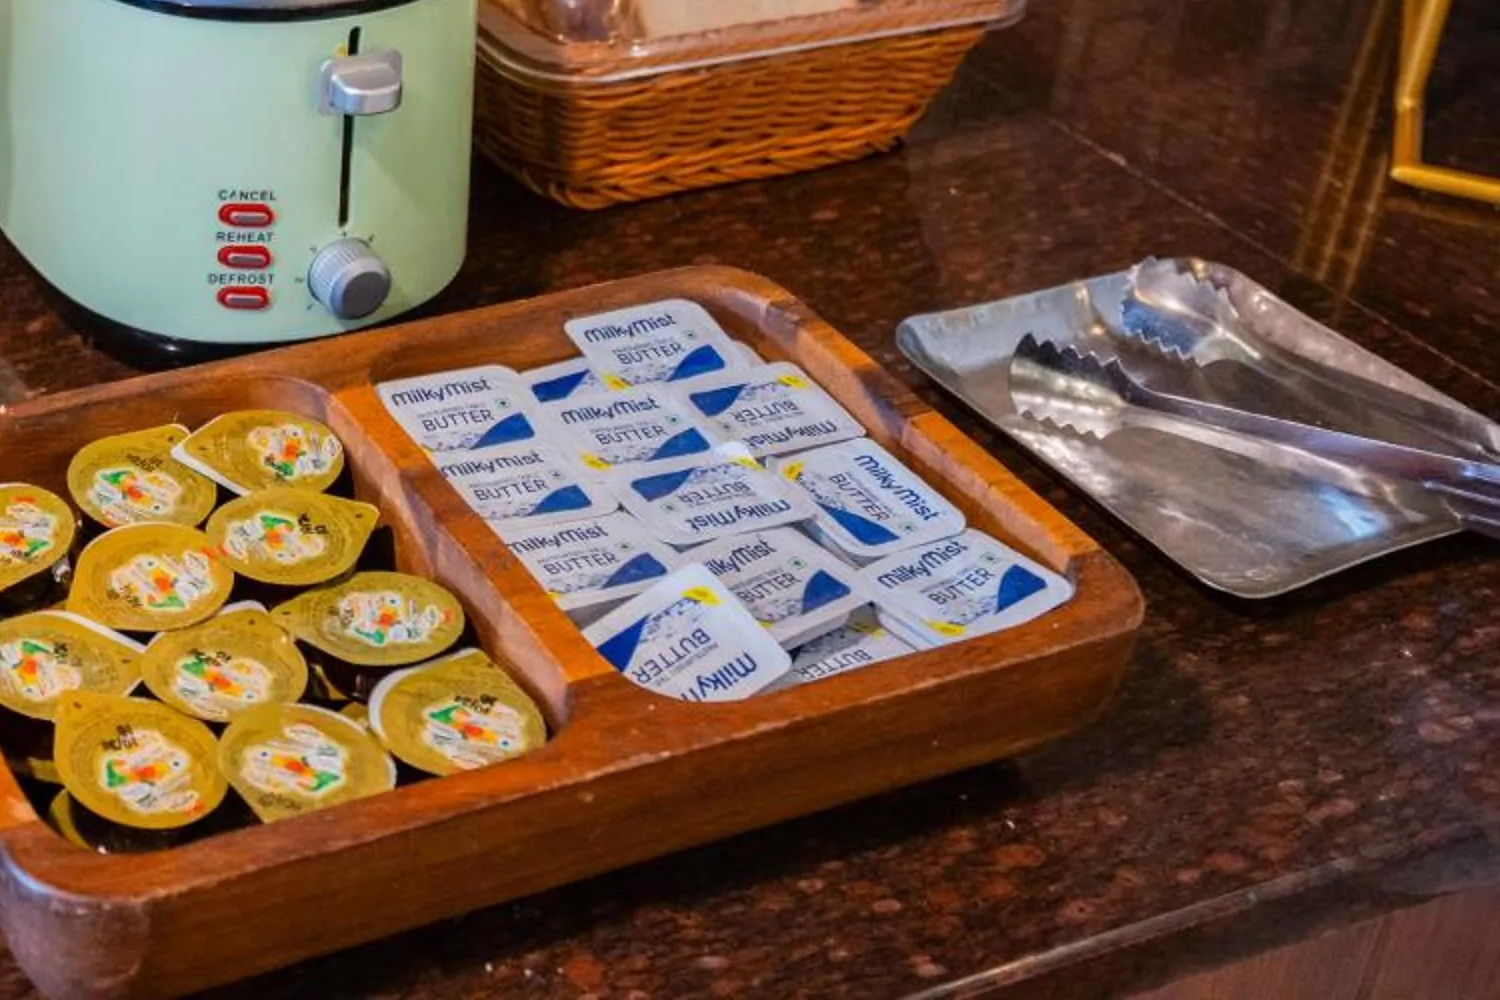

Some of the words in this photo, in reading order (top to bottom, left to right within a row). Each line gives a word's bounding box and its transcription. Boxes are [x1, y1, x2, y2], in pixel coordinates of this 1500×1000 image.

[217, 189, 276, 201] CANCEL
[215, 231, 274, 243] REHEAT
[207, 273, 276, 285] DEFROST
[617, 341, 685, 365] BUTTER
[421, 408, 495, 432] BUTTER
[733, 400, 799, 423] BUTTER
[595, 425, 668, 446] BUTTER
[473, 479, 549, 501] BUTTER
[677, 481, 750, 503] BUTTER
[828, 473, 891, 521] BUTTER
[543, 551, 623, 575] BUTTER
[736, 572, 802, 602] BUTTER
[928, 567, 995, 605] BUTTER
[632, 628, 712, 684] BUTTER
[793, 648, 873, 680] BUTTER
